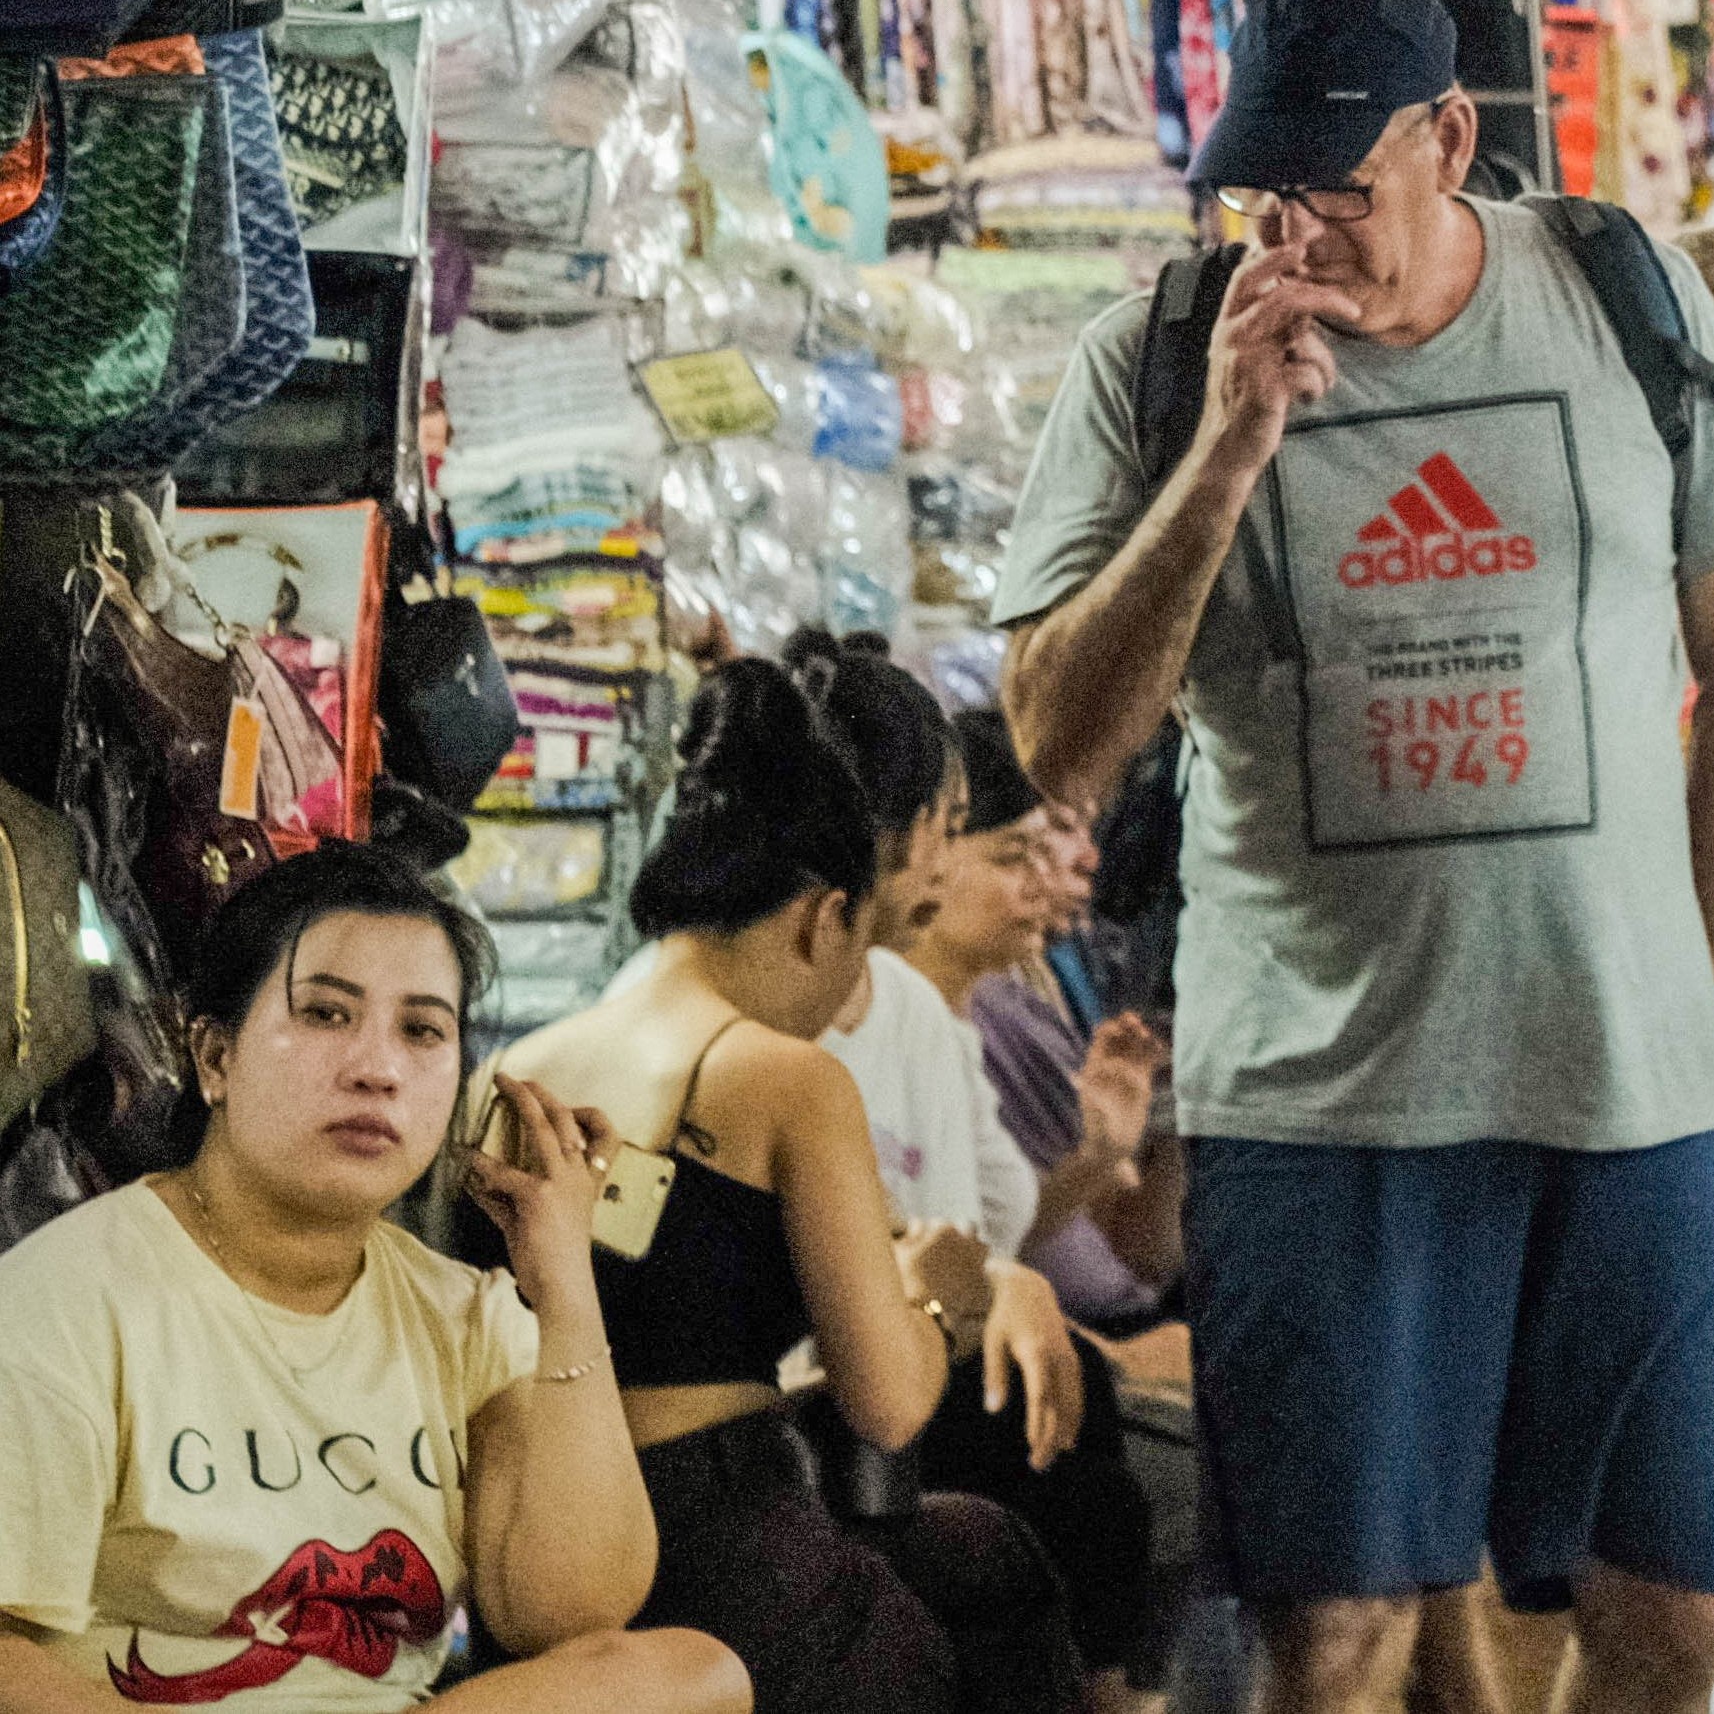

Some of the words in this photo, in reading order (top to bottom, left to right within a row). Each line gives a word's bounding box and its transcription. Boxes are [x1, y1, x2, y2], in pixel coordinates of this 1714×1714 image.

[1336, 533, 1538, 590] adidas
[1367, 660, 1435, 680] THREE
[1440, 651, 1524, 677] STRIPES
[1366, 686, 1527, 738] SINCE
[1368, 732, 1531, 795] 1949
